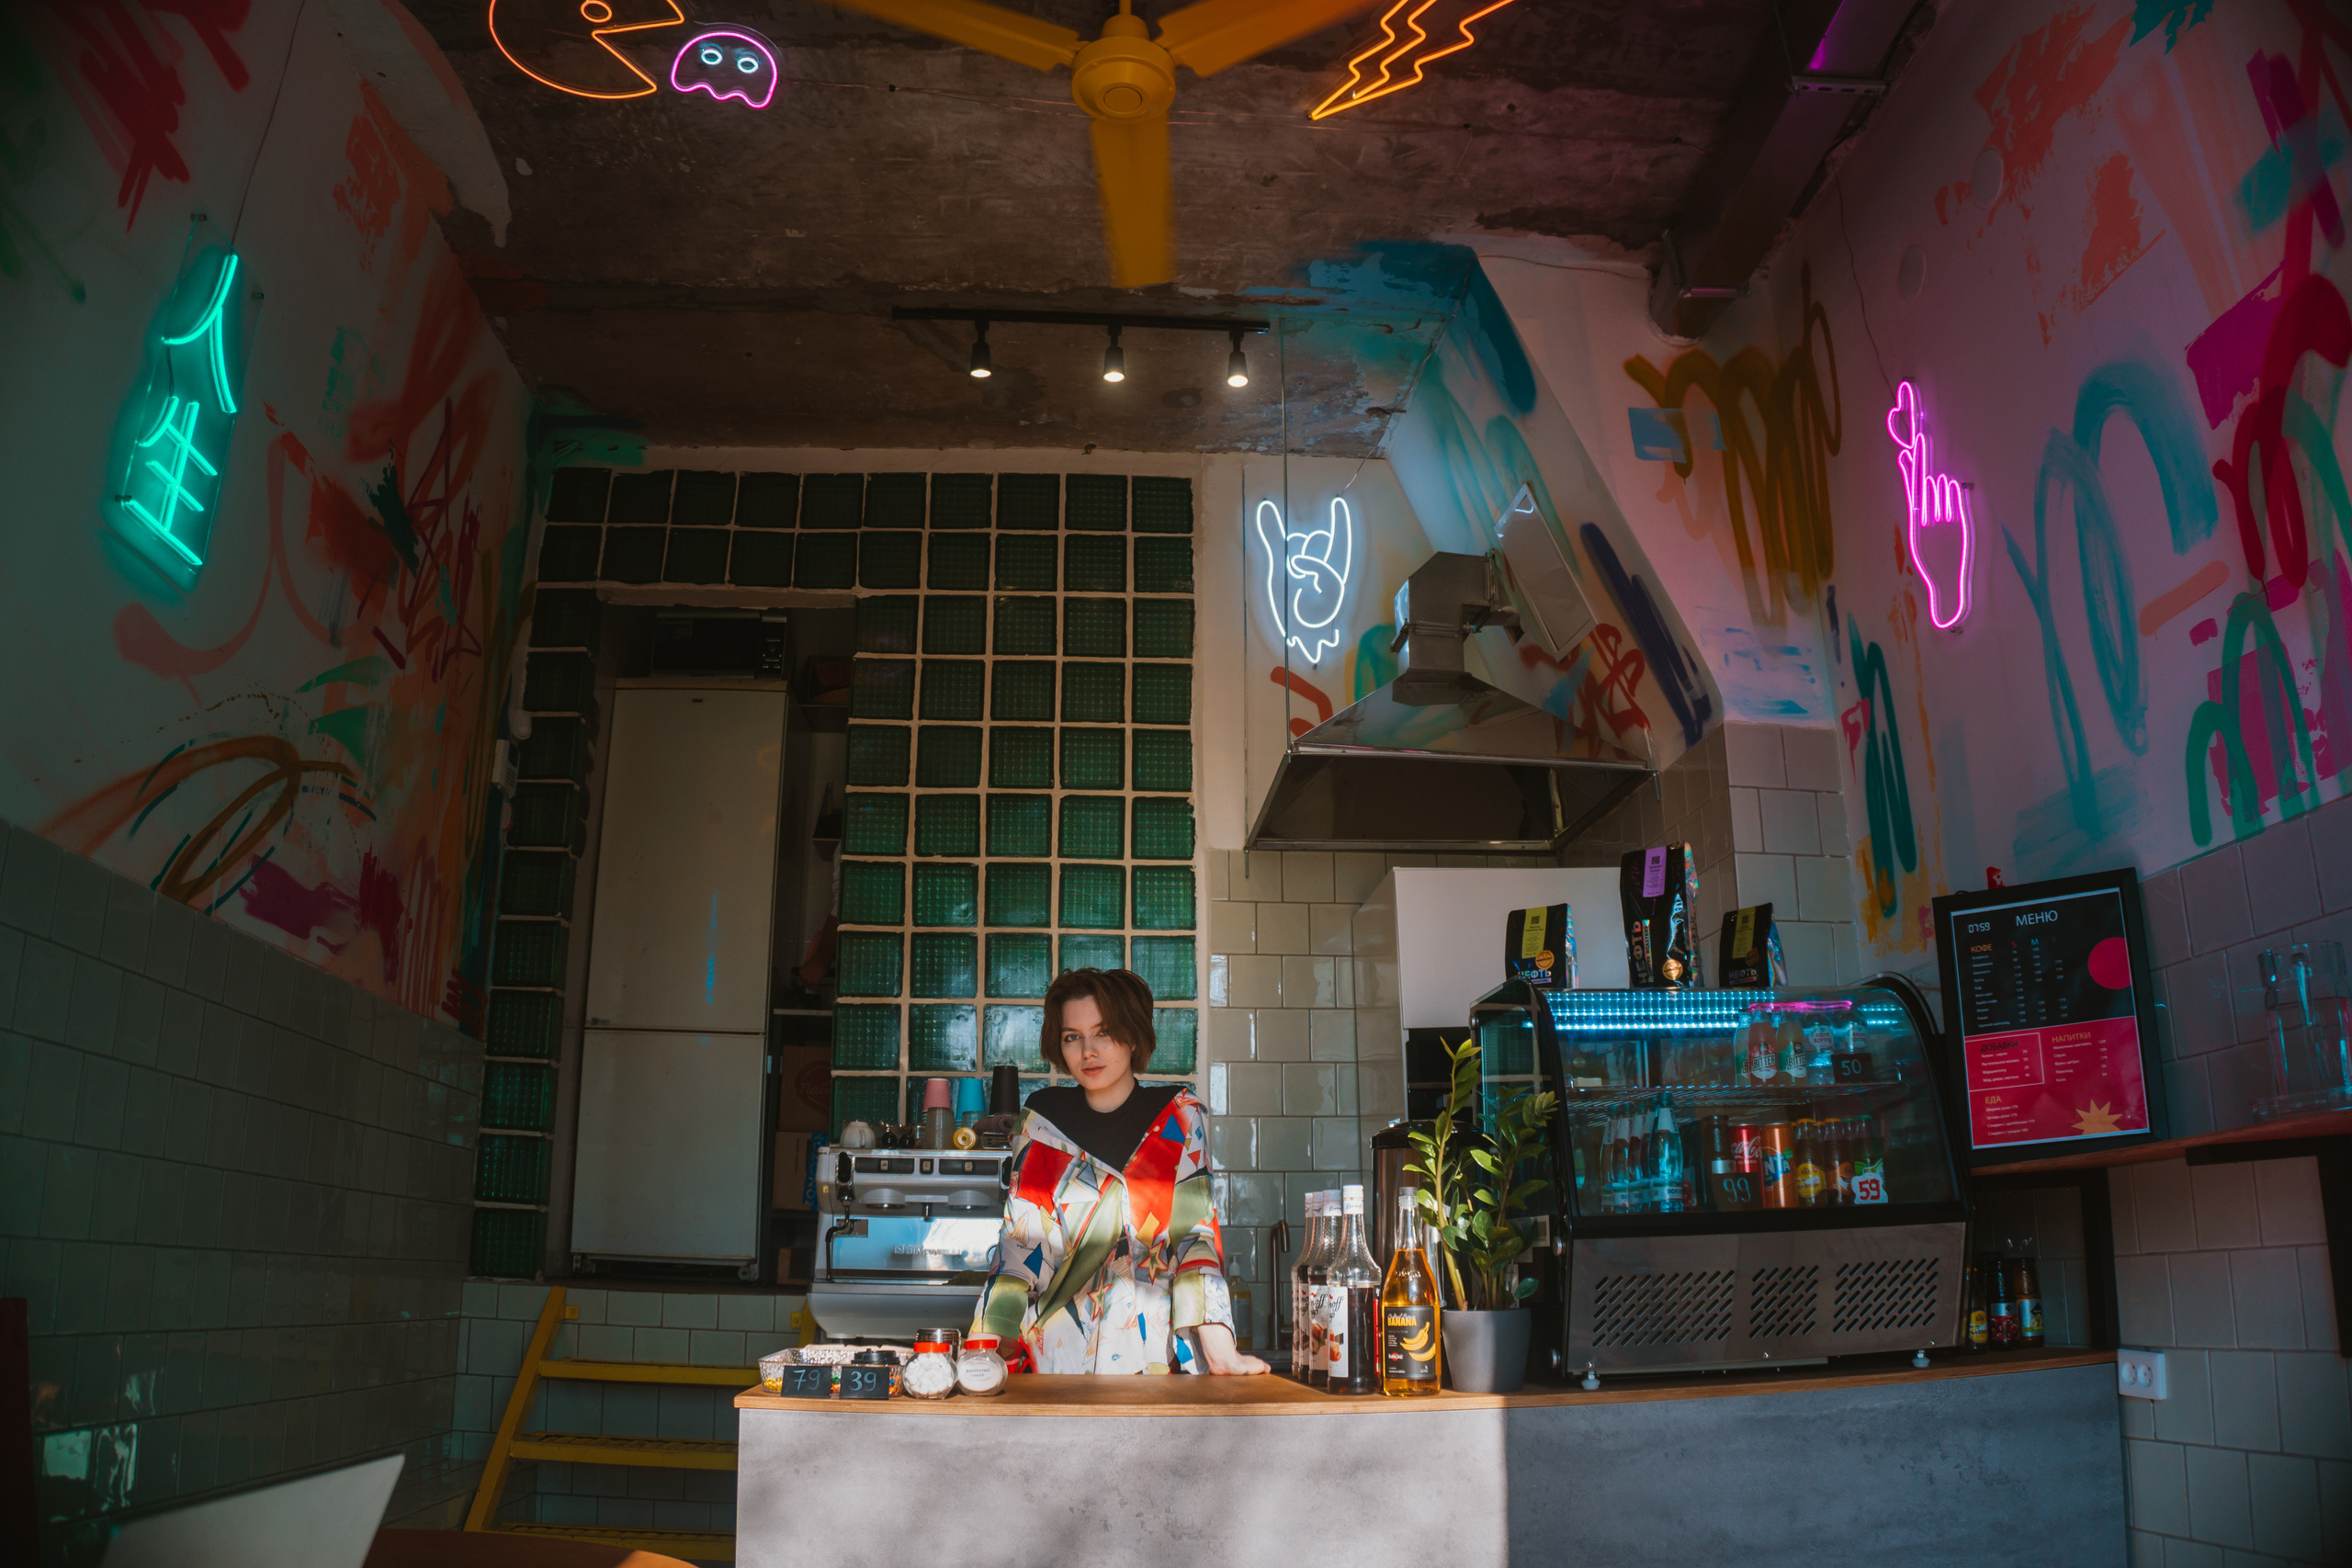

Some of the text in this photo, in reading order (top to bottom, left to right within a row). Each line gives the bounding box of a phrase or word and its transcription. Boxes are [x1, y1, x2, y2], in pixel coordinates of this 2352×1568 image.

[2016, 910, 2058, 927] МЕНЮ
[1968, 921, 1990, 933] 07:59
[1971, 943, 1993, 953] КОФЕ
[2030, 938, 2039, 946] M
[1631, 920, 1647, 985] НЕФТЬ
[1728, 968, 1758, 980] НЕФТЬ
[2052, 1032, 2091, 1043] НАПИТКИ
[1981, 1040, 2018, 1053] ДОБАВКИ
[1753, 1055, 1775, 1068] BITTER
[1789, 1055, 1805, 1066] BITTE
[1841, 1059, 1862, 1076] 50
[1984, 1095, 2002, 1104] ЕДА
[1723, 1178, 1752, 1203] 99
[1859, 1179, 1881, 1201] 59
[1387, 1317, 1418, 1326] BANANA
[793, 1369, 821, 1391] 79
[849, 1371, 877, 1392] 39
